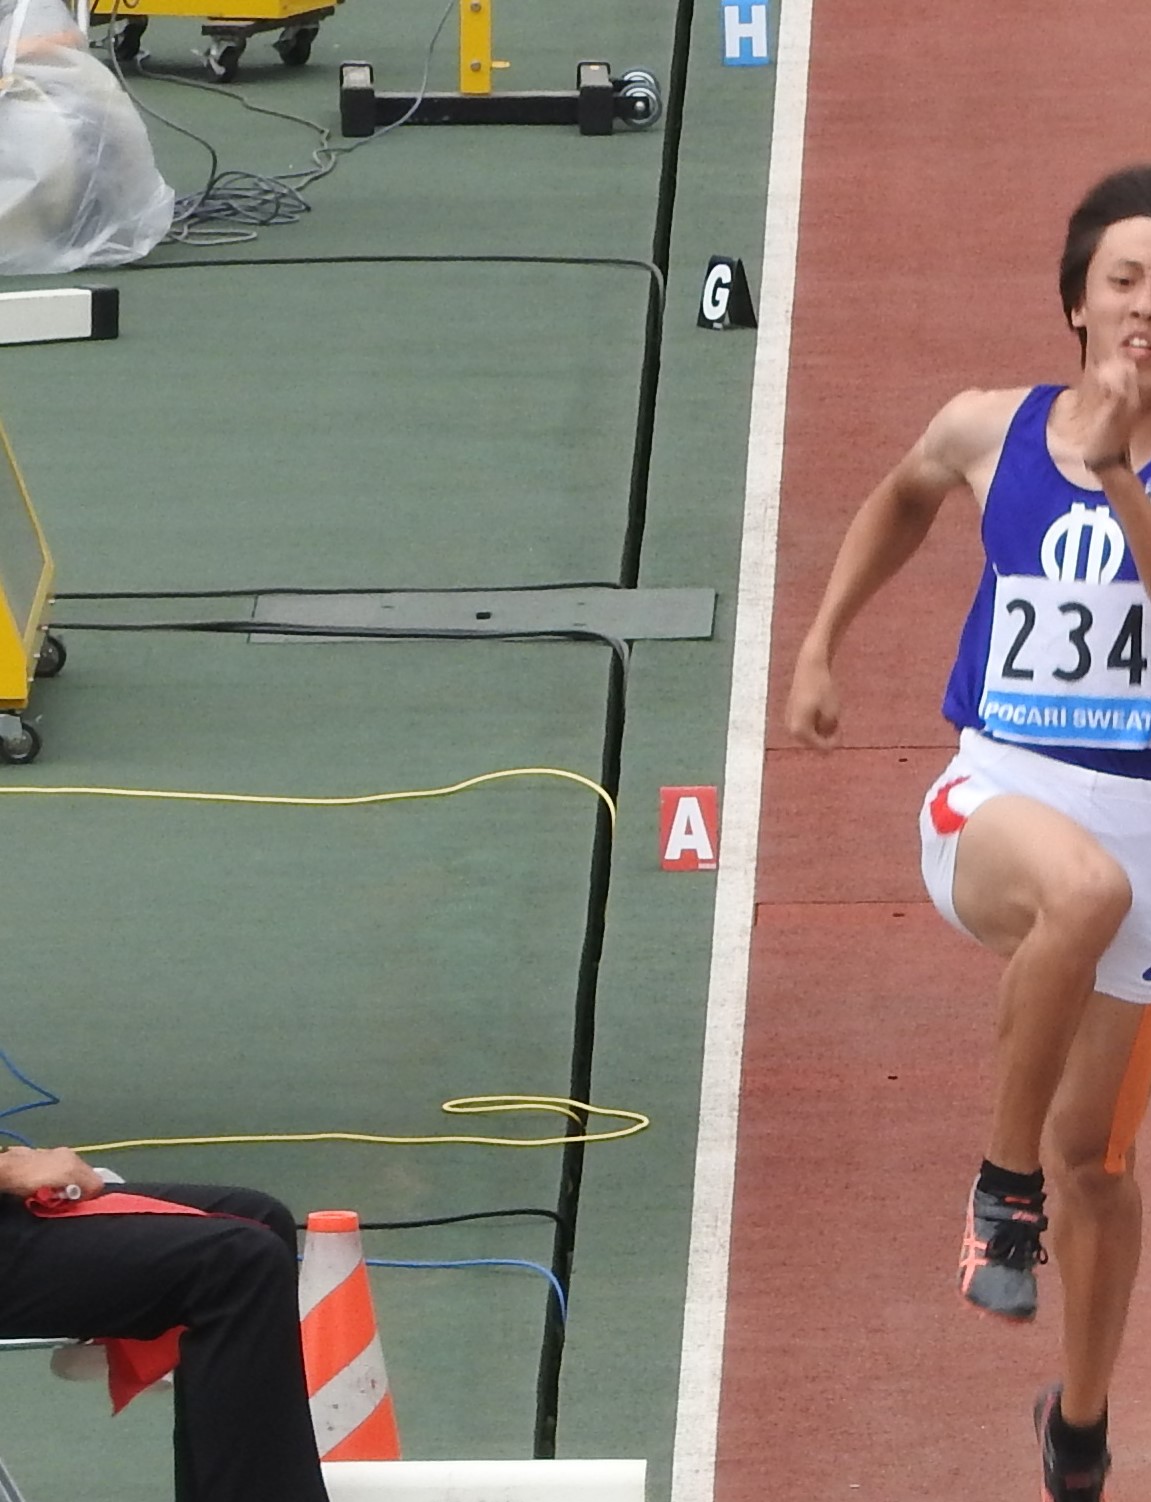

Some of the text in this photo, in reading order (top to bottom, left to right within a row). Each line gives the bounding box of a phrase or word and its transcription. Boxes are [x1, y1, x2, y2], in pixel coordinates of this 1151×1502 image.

[725, 5, 767, 57] H
[703, 264, 731, 320] G
[1001, 598, 1147, 686] 234
[984, 701, 1151, 731] POCARI SWEAT
[664, 797, 713, 859] A
